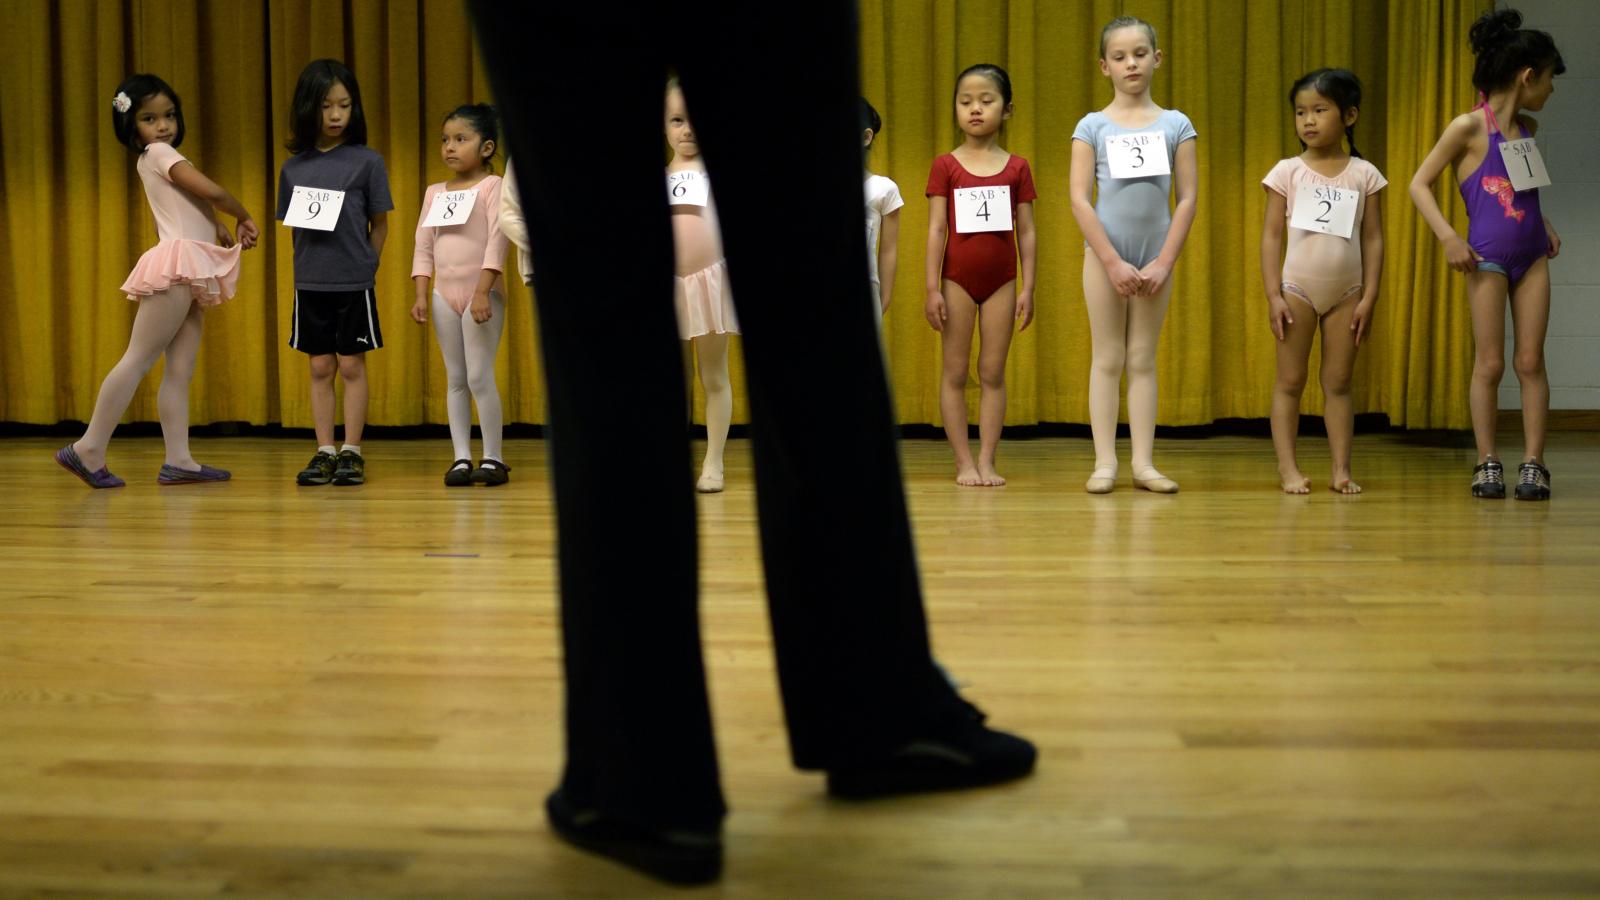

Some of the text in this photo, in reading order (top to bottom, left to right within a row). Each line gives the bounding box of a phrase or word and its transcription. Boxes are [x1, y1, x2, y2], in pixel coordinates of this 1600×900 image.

[1122, 136, 1148, 147] SAB
[1513, 142, 1531, 155] SAB
[1130, 147, 1144, 168] 3
[1524, 155, 1533, 177] 1
[306, 191, 329, 201] SAB
[446, 193, 465, 201] SAB
[672, 181, 686, 197] 6
[970, 190, 995, 200] SAB
[1314, 187, 1341, 200] SAB
[306, 202, 321, 220] 9
[443, 202, 457, 219] 8
[976, 201, 990, 221] 4
[1315, 201, 1331, 223] 2
